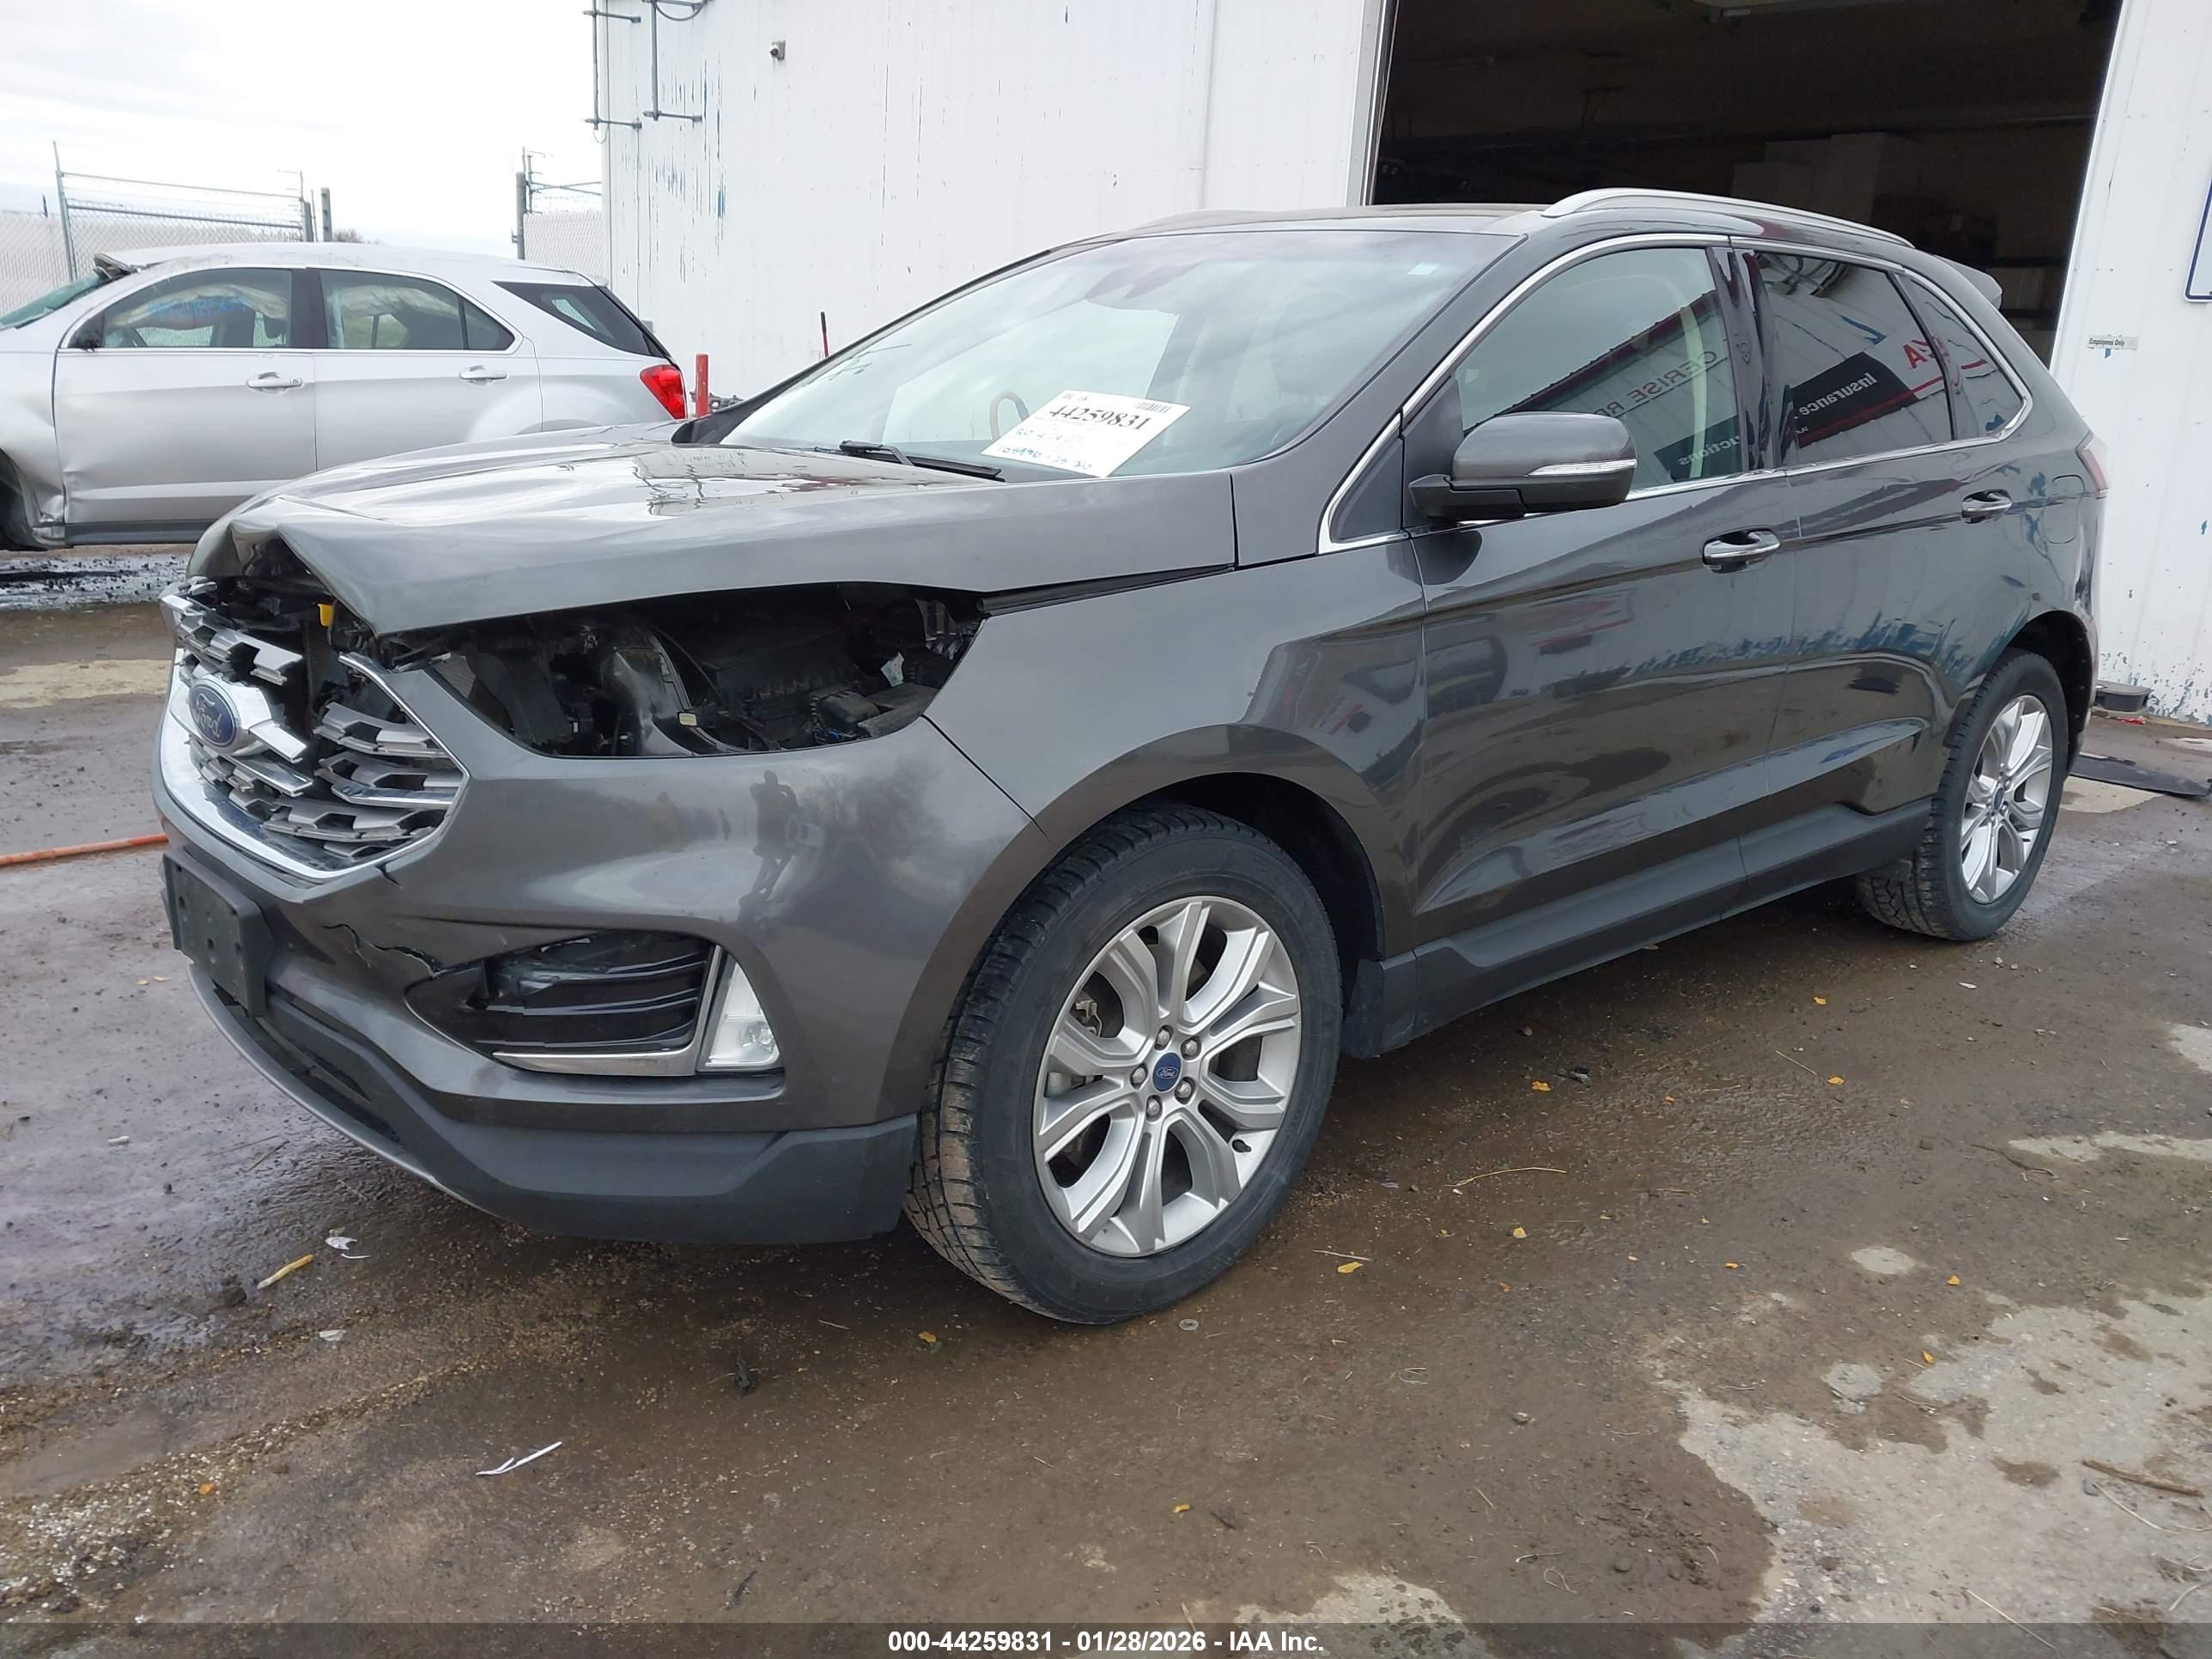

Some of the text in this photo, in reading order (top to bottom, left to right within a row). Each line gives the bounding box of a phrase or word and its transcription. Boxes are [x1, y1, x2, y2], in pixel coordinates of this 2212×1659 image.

[2114, 338, 2124, 347] Only
[1049, 405, 1152, 429] 44259831
[195, 693, 222, 738] Ford
[1159, 1067, 1176, 1078] Ford
